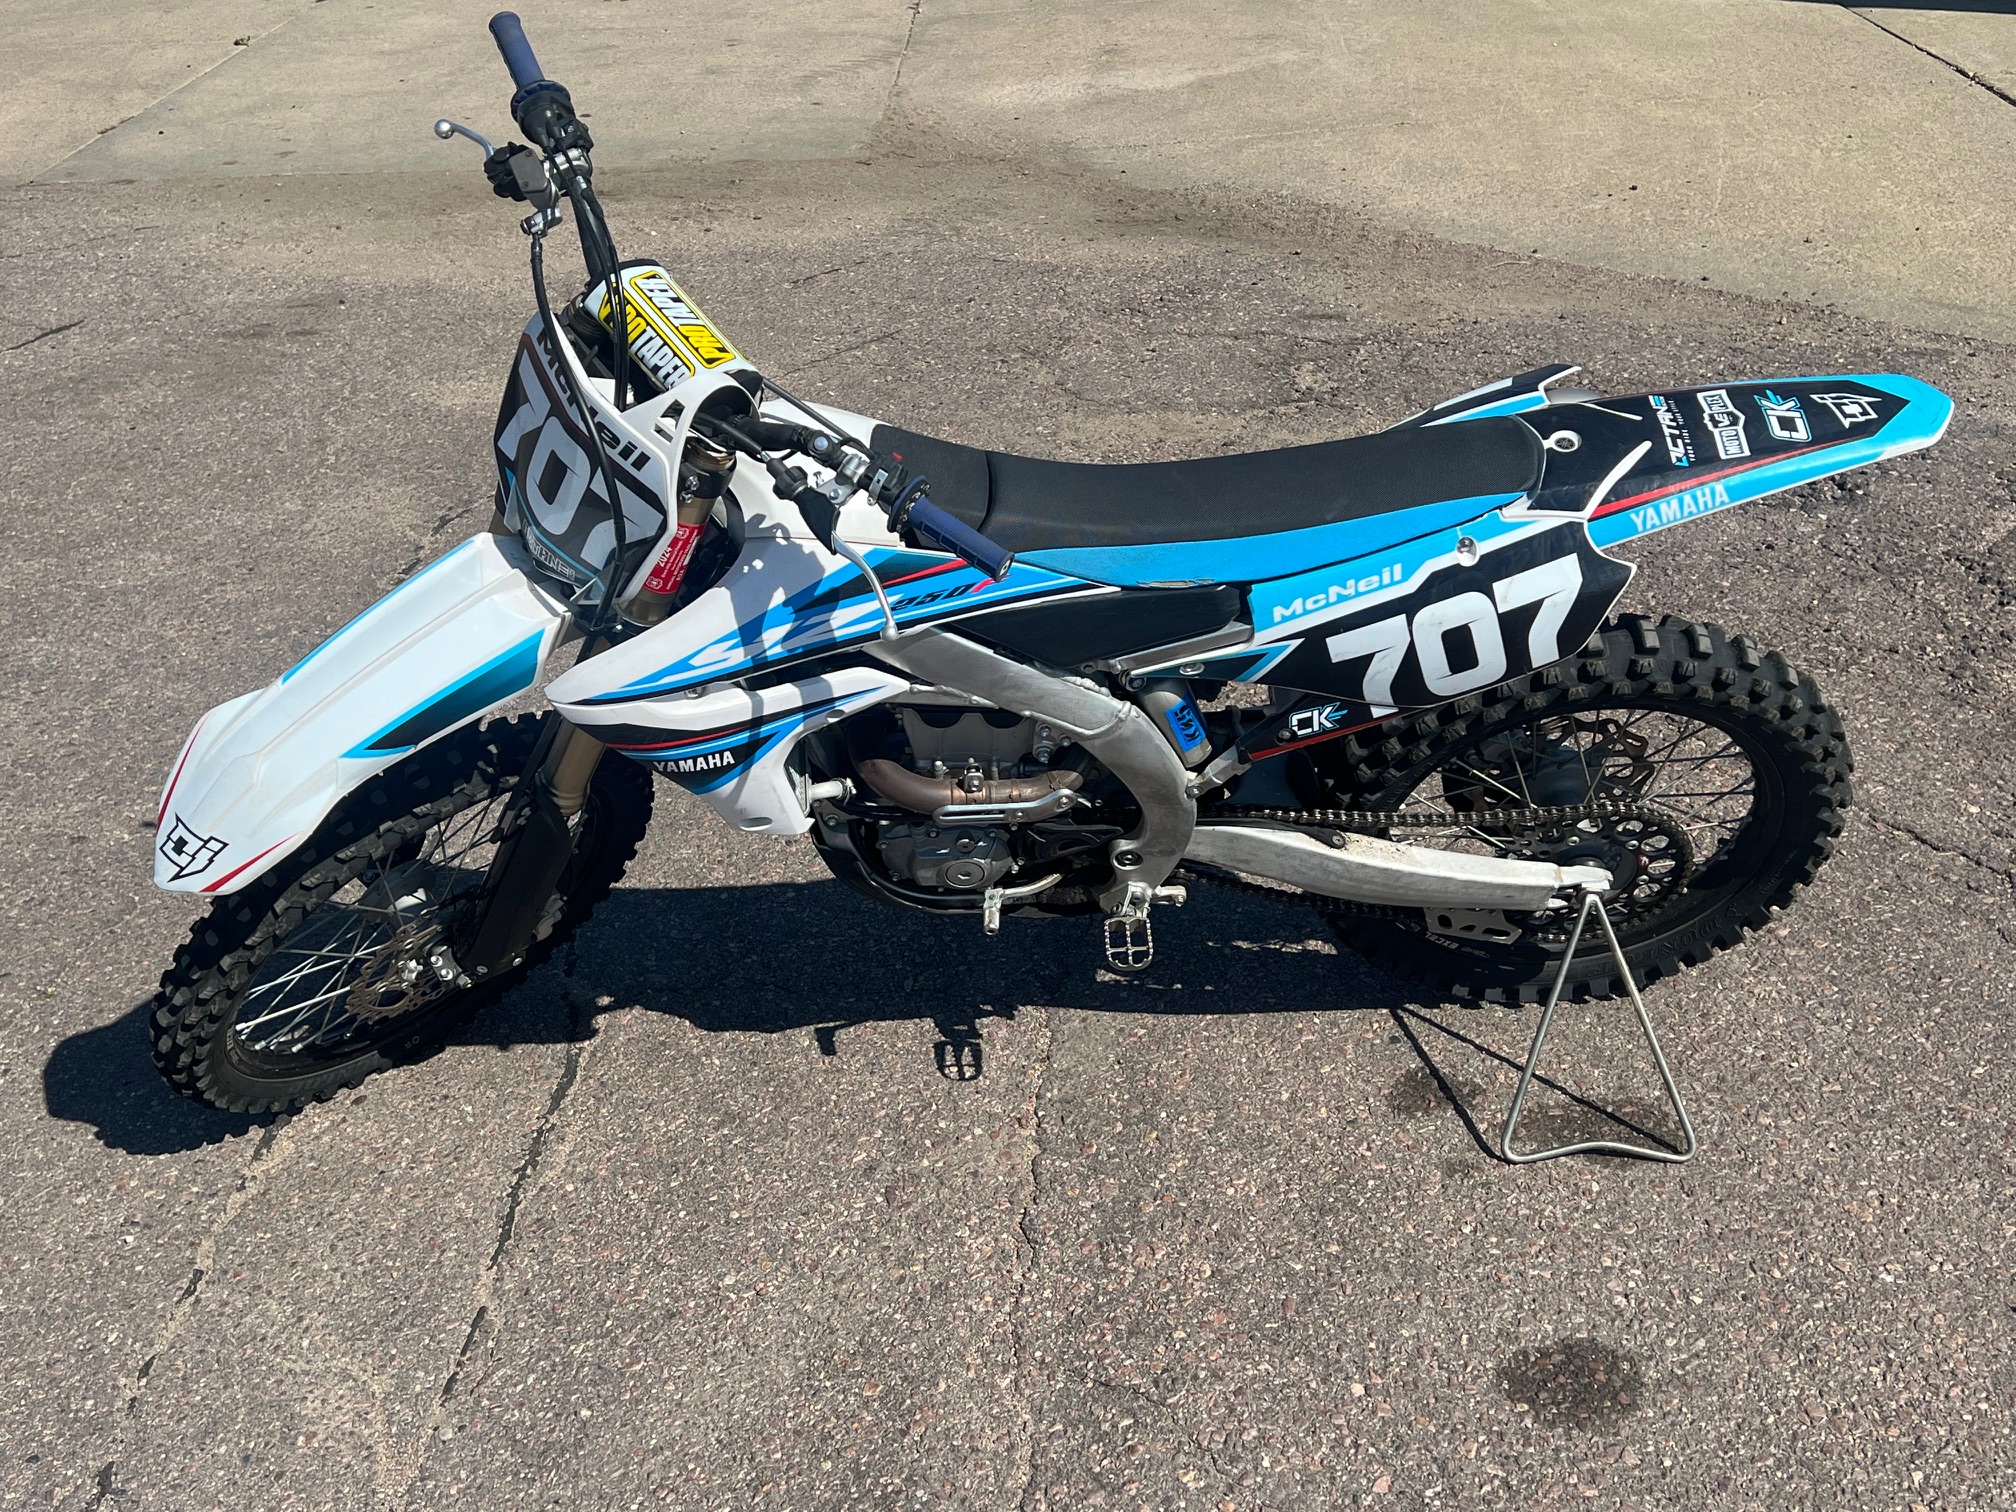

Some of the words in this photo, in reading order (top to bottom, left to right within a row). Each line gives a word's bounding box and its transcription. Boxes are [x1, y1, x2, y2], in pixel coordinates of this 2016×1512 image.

[608, 290, 692, 390] ROTAPER
[497, 348, 664, 571] 707
[1720, 428, 1745, 457] MOTO
[1630, 483, 1731, 534] YAMAHA
[1272, 563, 1403, 624] McNeil
[1325, 553, 1583, 719] 707
[653, 750, 735, 774] YAMAHA
[1424, 931, 1460, 950] EXCEL
